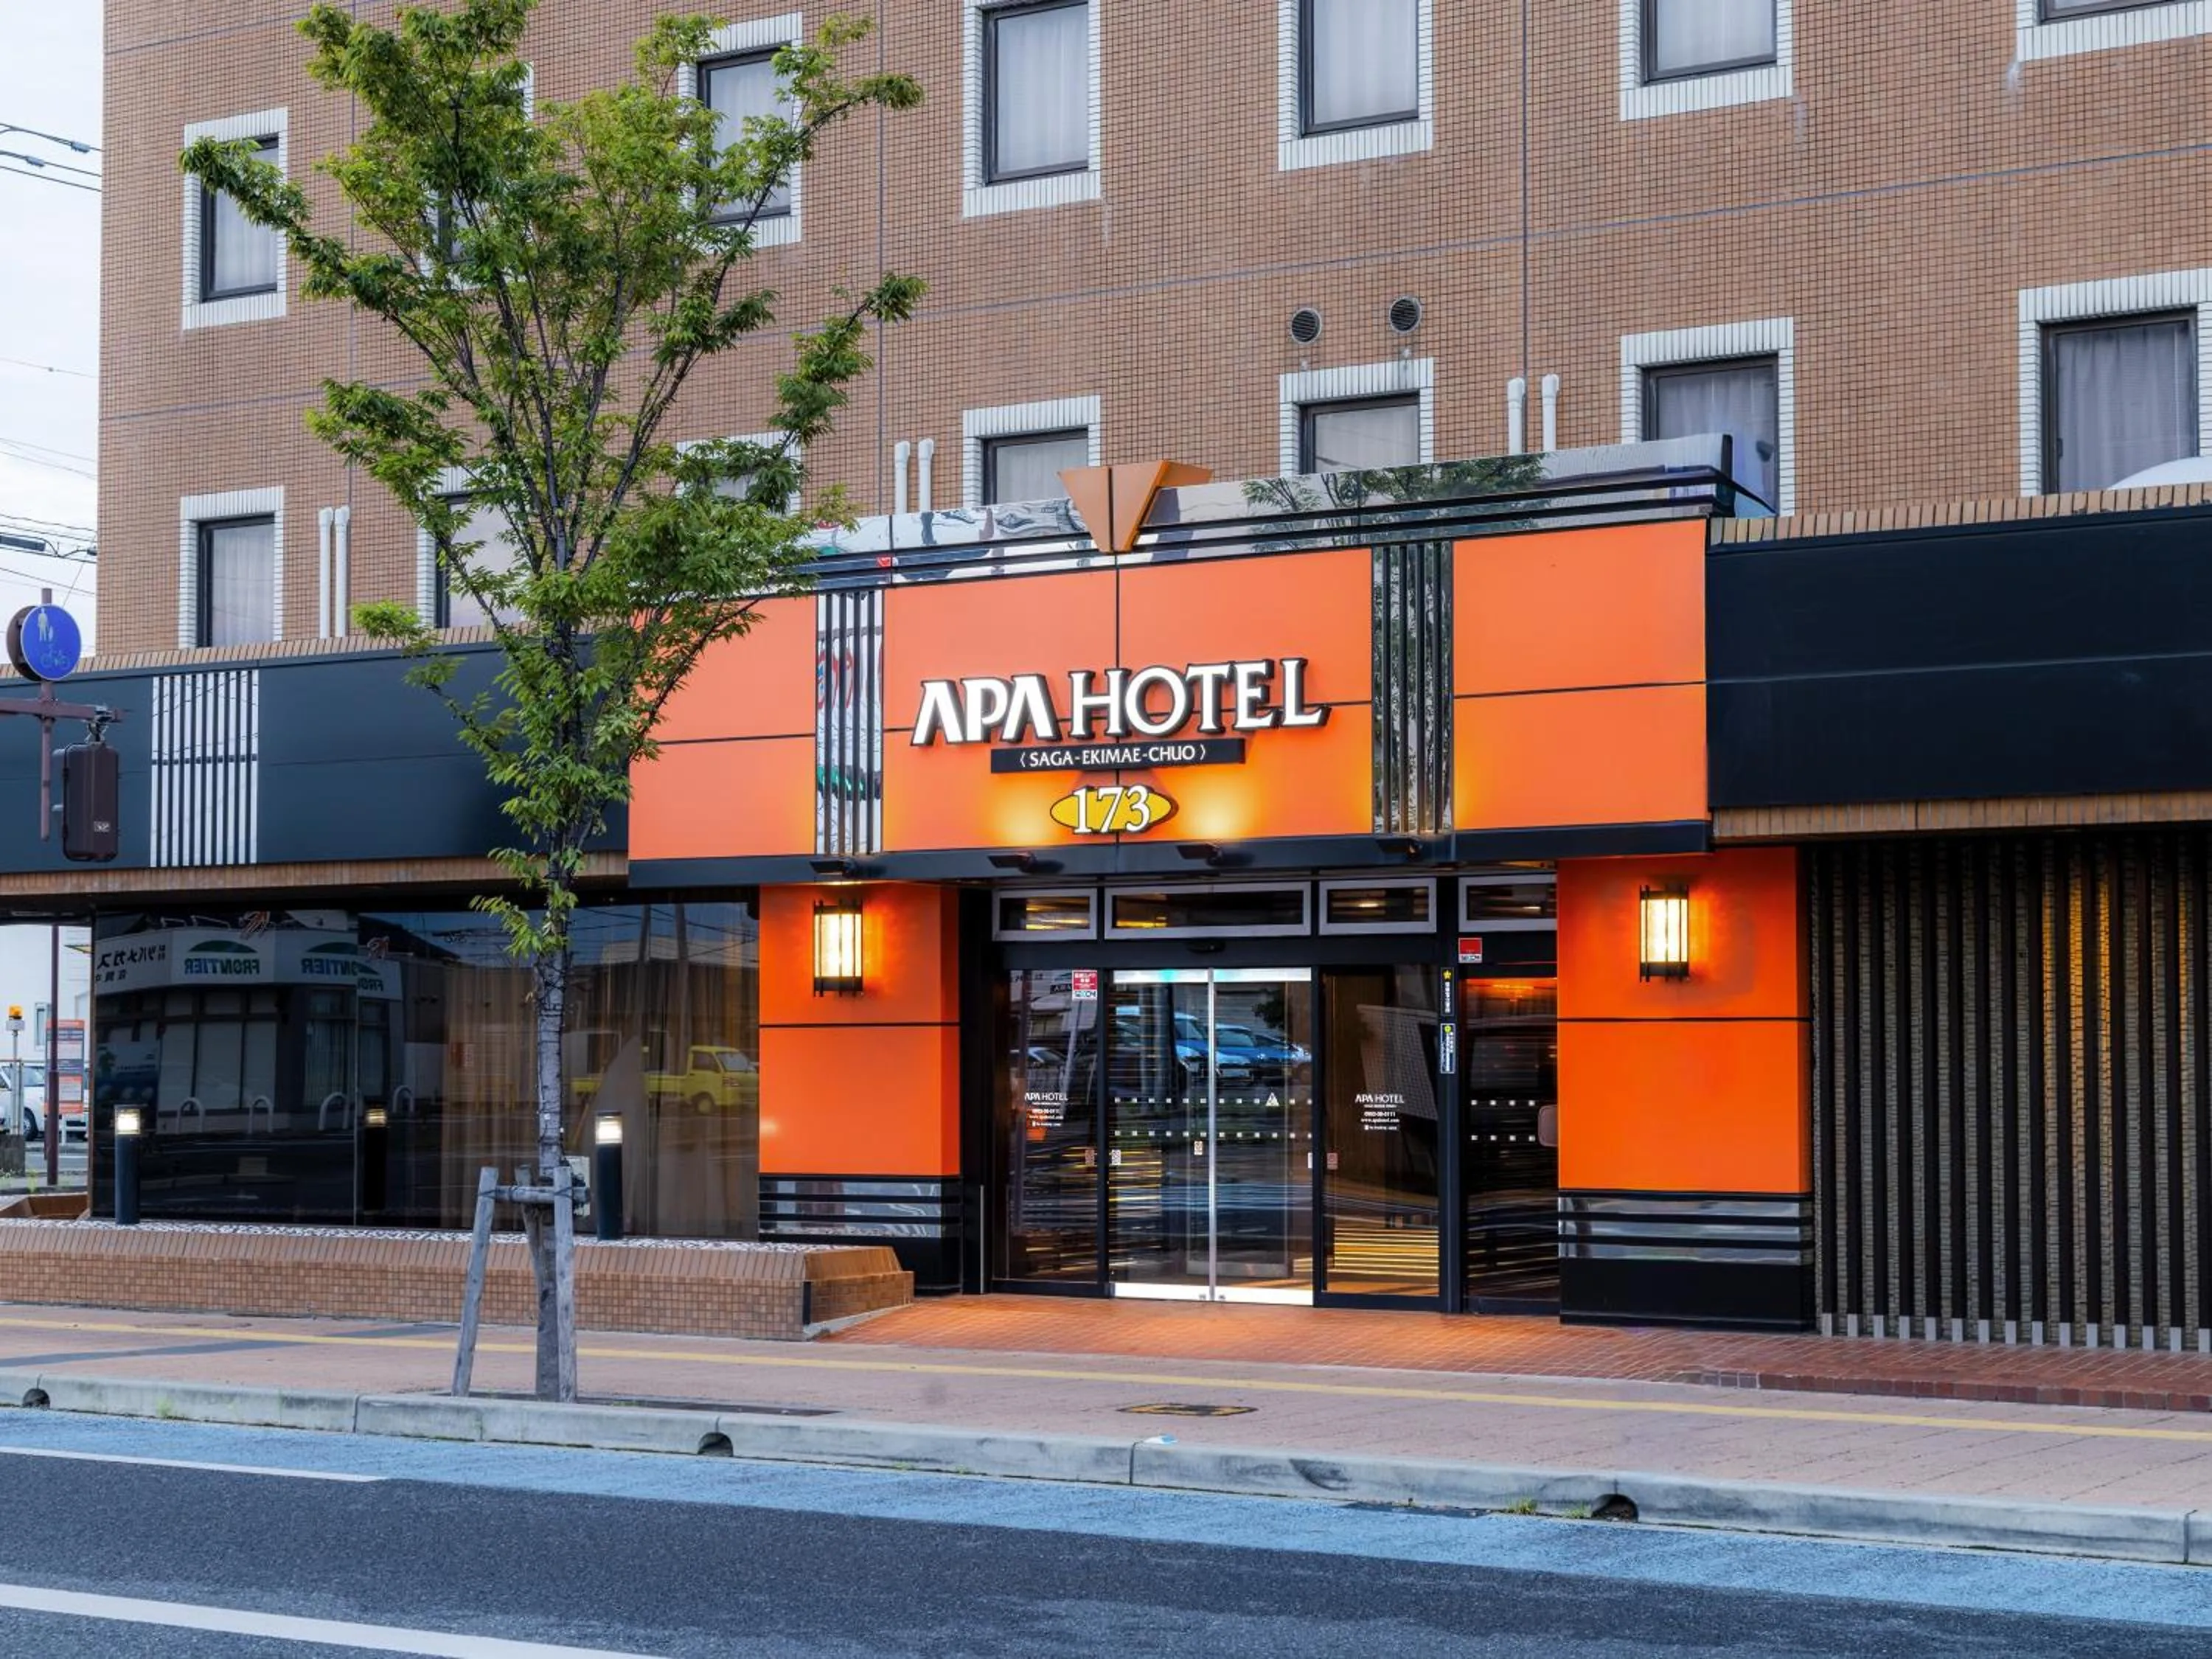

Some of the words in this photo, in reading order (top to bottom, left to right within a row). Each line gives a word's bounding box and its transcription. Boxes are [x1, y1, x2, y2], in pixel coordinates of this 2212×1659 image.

[911, 674, 1060, 745] APA
[1068, 658, 1329, 740] HOTEL
[1072, 785, 1152, 834] 173
[1024, 1092, 1040, 1101] APA
[1042, 1092, 1068, 1101] HOTEL
[1355, 1093, 1374, 1103] APA
[1374, 1094, 1405, 1104] HOTEL
